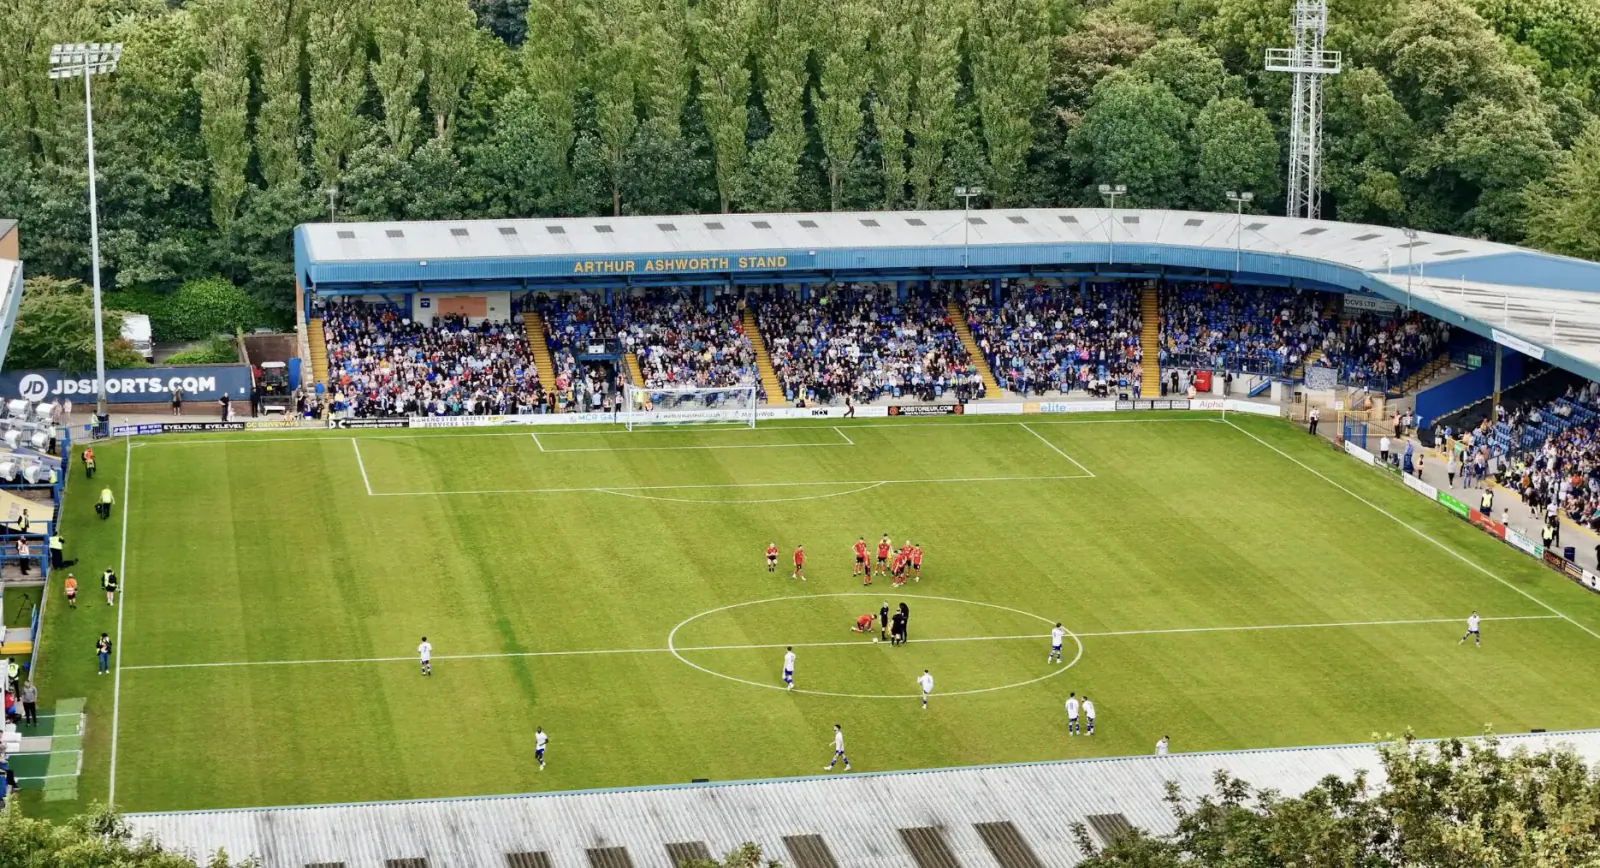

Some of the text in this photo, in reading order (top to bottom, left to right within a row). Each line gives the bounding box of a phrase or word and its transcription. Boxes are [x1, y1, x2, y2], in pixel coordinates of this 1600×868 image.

[574, 256, 787, 273] ARTHUR ASHWORTH STAND
[24, 380, 44, 395] JD
[1040, 402, 1067, 412] elite
